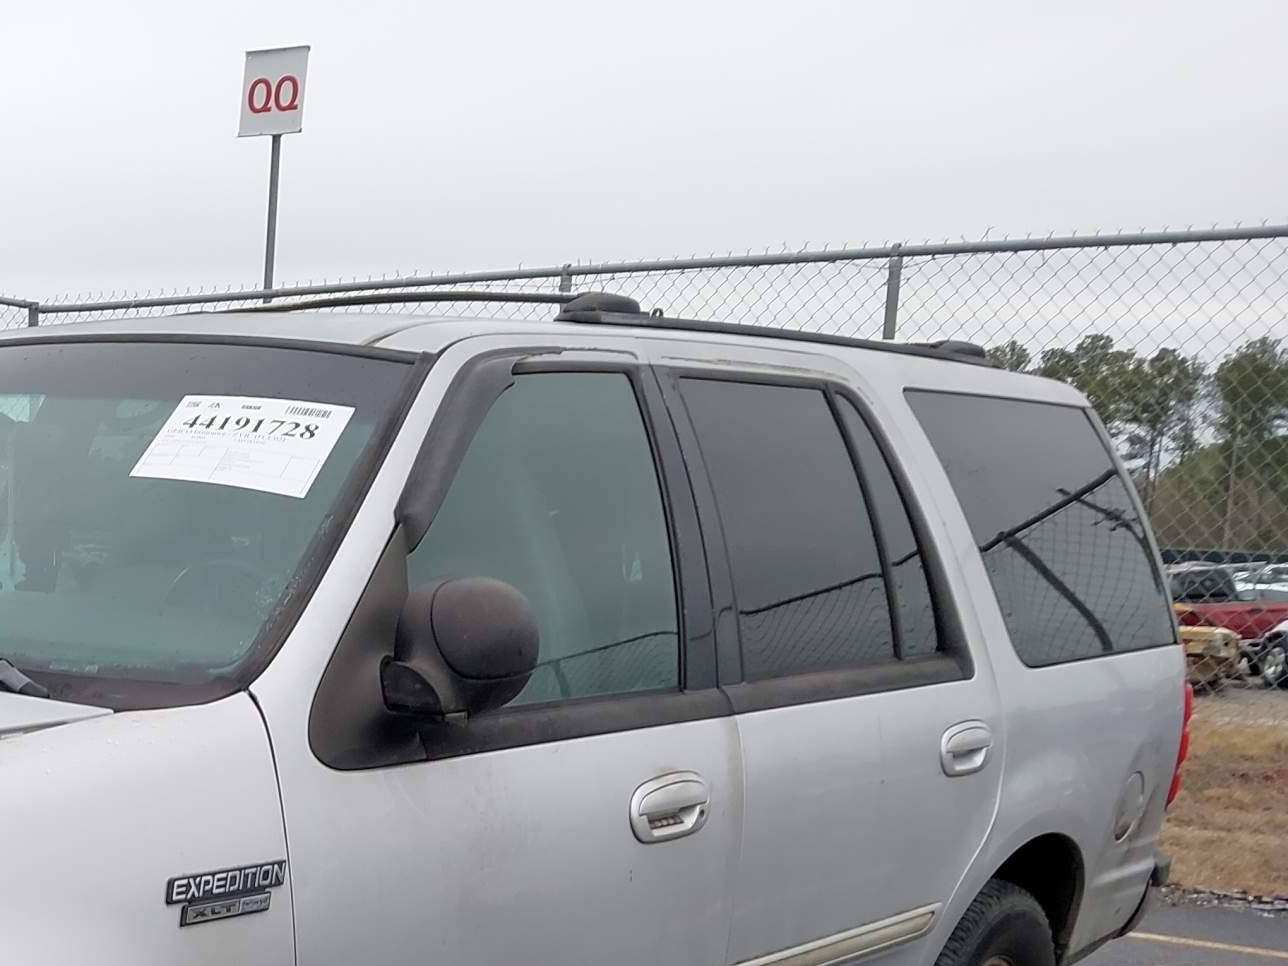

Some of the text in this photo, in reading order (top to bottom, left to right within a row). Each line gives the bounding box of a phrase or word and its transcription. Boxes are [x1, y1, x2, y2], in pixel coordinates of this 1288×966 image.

[248, 75, 299, 114] QQ
[182, 413, 320, 440] 44191728
[172, 862, 286, 901] EXPEDITION
[193, 903, 237, 919] XLT
